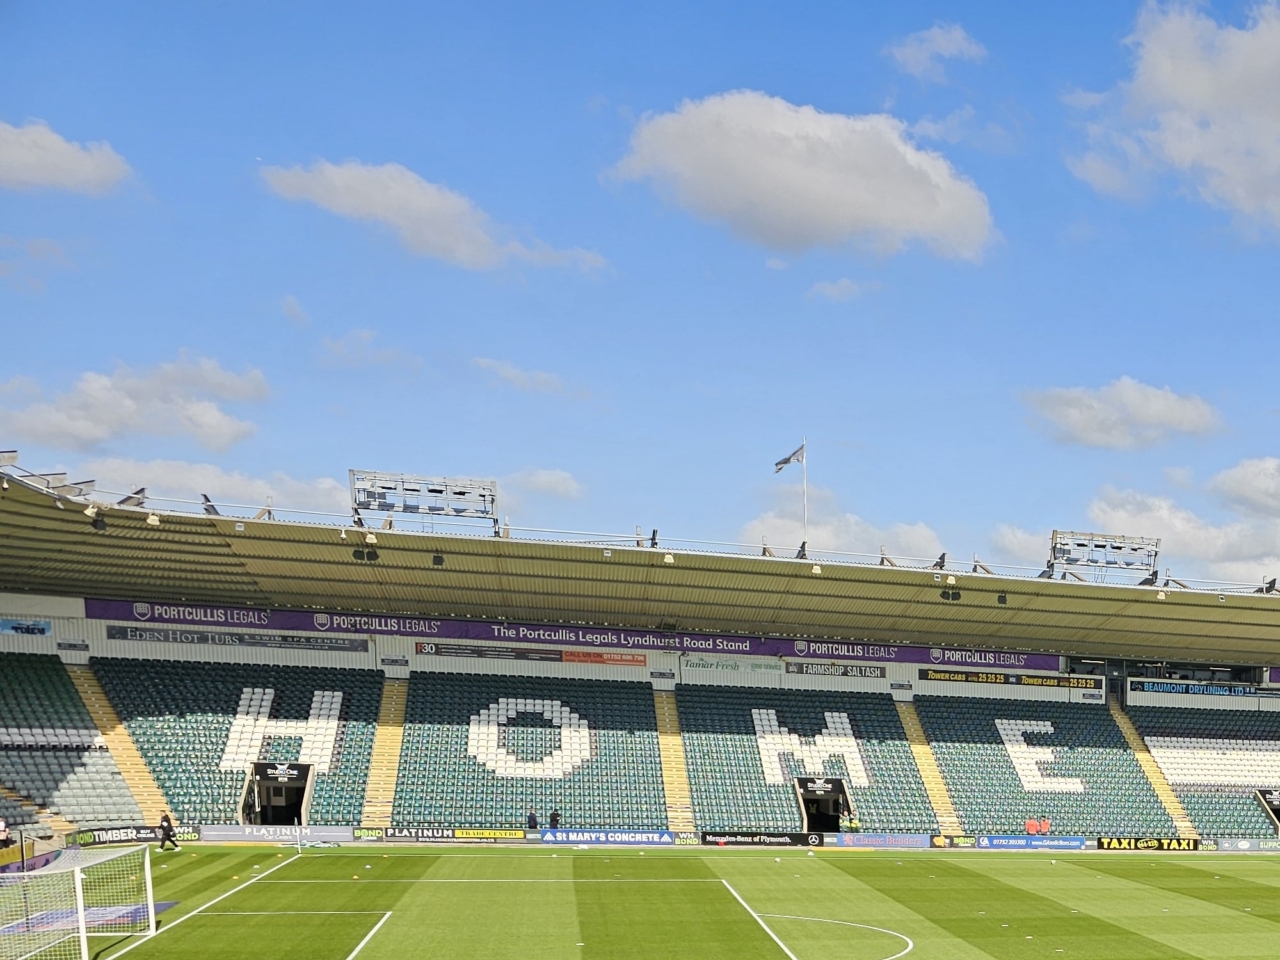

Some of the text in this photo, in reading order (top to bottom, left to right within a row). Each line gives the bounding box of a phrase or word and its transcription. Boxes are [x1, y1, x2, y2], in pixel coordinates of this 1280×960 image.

[154, 605, 226, 622] PORTCULLIS
[333, 616, 398, 631] PORTCULLIS
[127, 628, 239, 645] EDEN HOT TUBS
[491, 625, 750, 651] The Portcullis Legals Lyndhurst Road Stand
[810, 643, 863, 656] PORTCULLIS
[945, 650, 994, 663] PORTCULLIS
[684, 659, 739, 671] Tamar Fresh
[803, 664, 881, 677] FARMSHOP SALTASH
[927, 671, 949, 680] TOWER
[950, 673, 965, 681] CABS
[979, 673, 987, 682] 25
[987, 674, 995, 682] 25
[996, 674, 1004, 683] 25
[1021, 676, 1042, 684] TOWER
[1043, 678, 1058, 686] CABS
[1070, 678, 1078, 687] 25
[1078, 679, 1086, 687] 25
[1087, 679, 1094, 688] 25
[1144, 682, 1187, 693] BEAUMONT
[1189, 685, 1229, 695] DRYLINING
[1231, 687, 1244, 696] LTD
[93, 828, 137, 842] TIMBER
[245, 827, 311, 836] PLATINUM
[354, 829, 383, 837] BOND
[387, 828, 453, 838] PLATINUM
[556, 832, 660, 843] St MARY'S CONCRETE
[706, 835, 752, 843] Mercedes-Benz
[854, 836, 923, 846] Classic Builders
[953, 836, 976, 844] BOND
[1101, 838, 1135, 850] TAXI
[1161, 838, 1194, 850] TAXI
